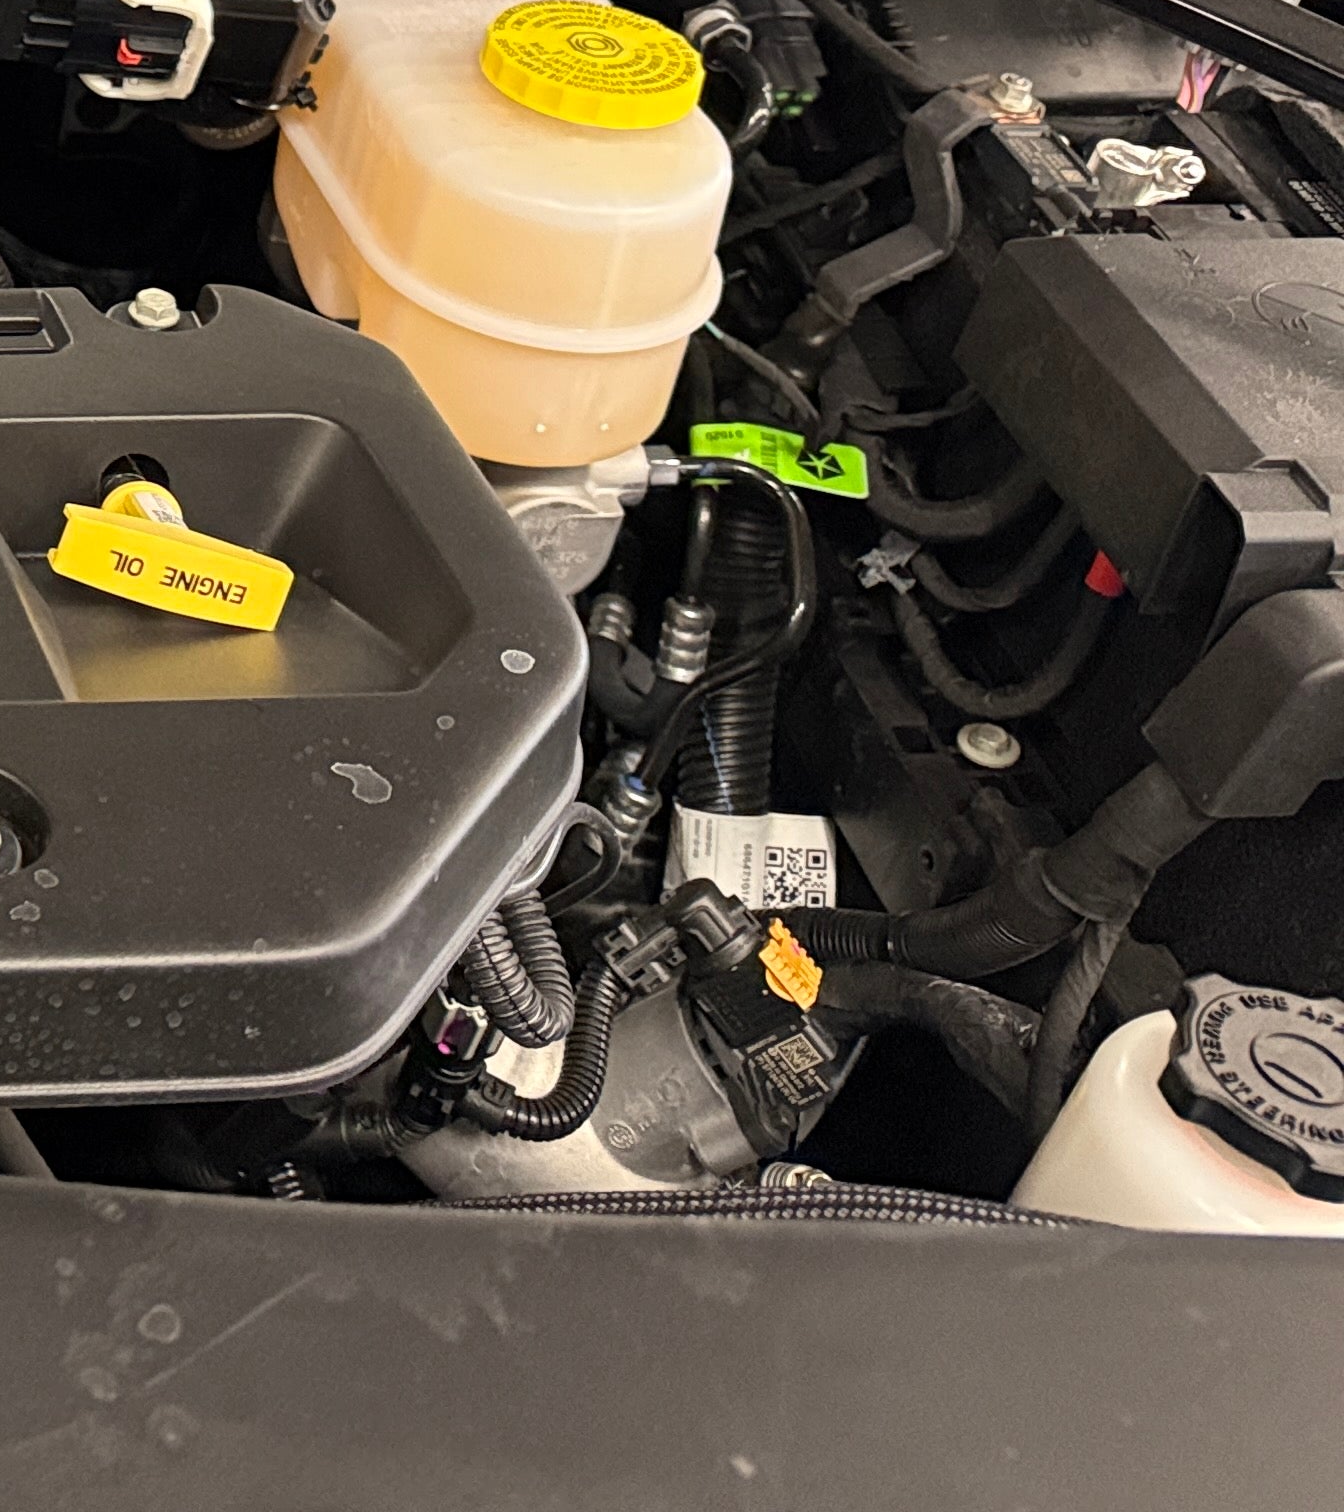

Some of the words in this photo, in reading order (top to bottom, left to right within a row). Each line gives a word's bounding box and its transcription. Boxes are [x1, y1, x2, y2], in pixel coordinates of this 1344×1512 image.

[110, 549, 145, 577] OIL
[159, 565, 248, 605] ENGINE
[1238, 994, 1290, 1012] USE
[1202, 1001, 1235, 1065] POWER
